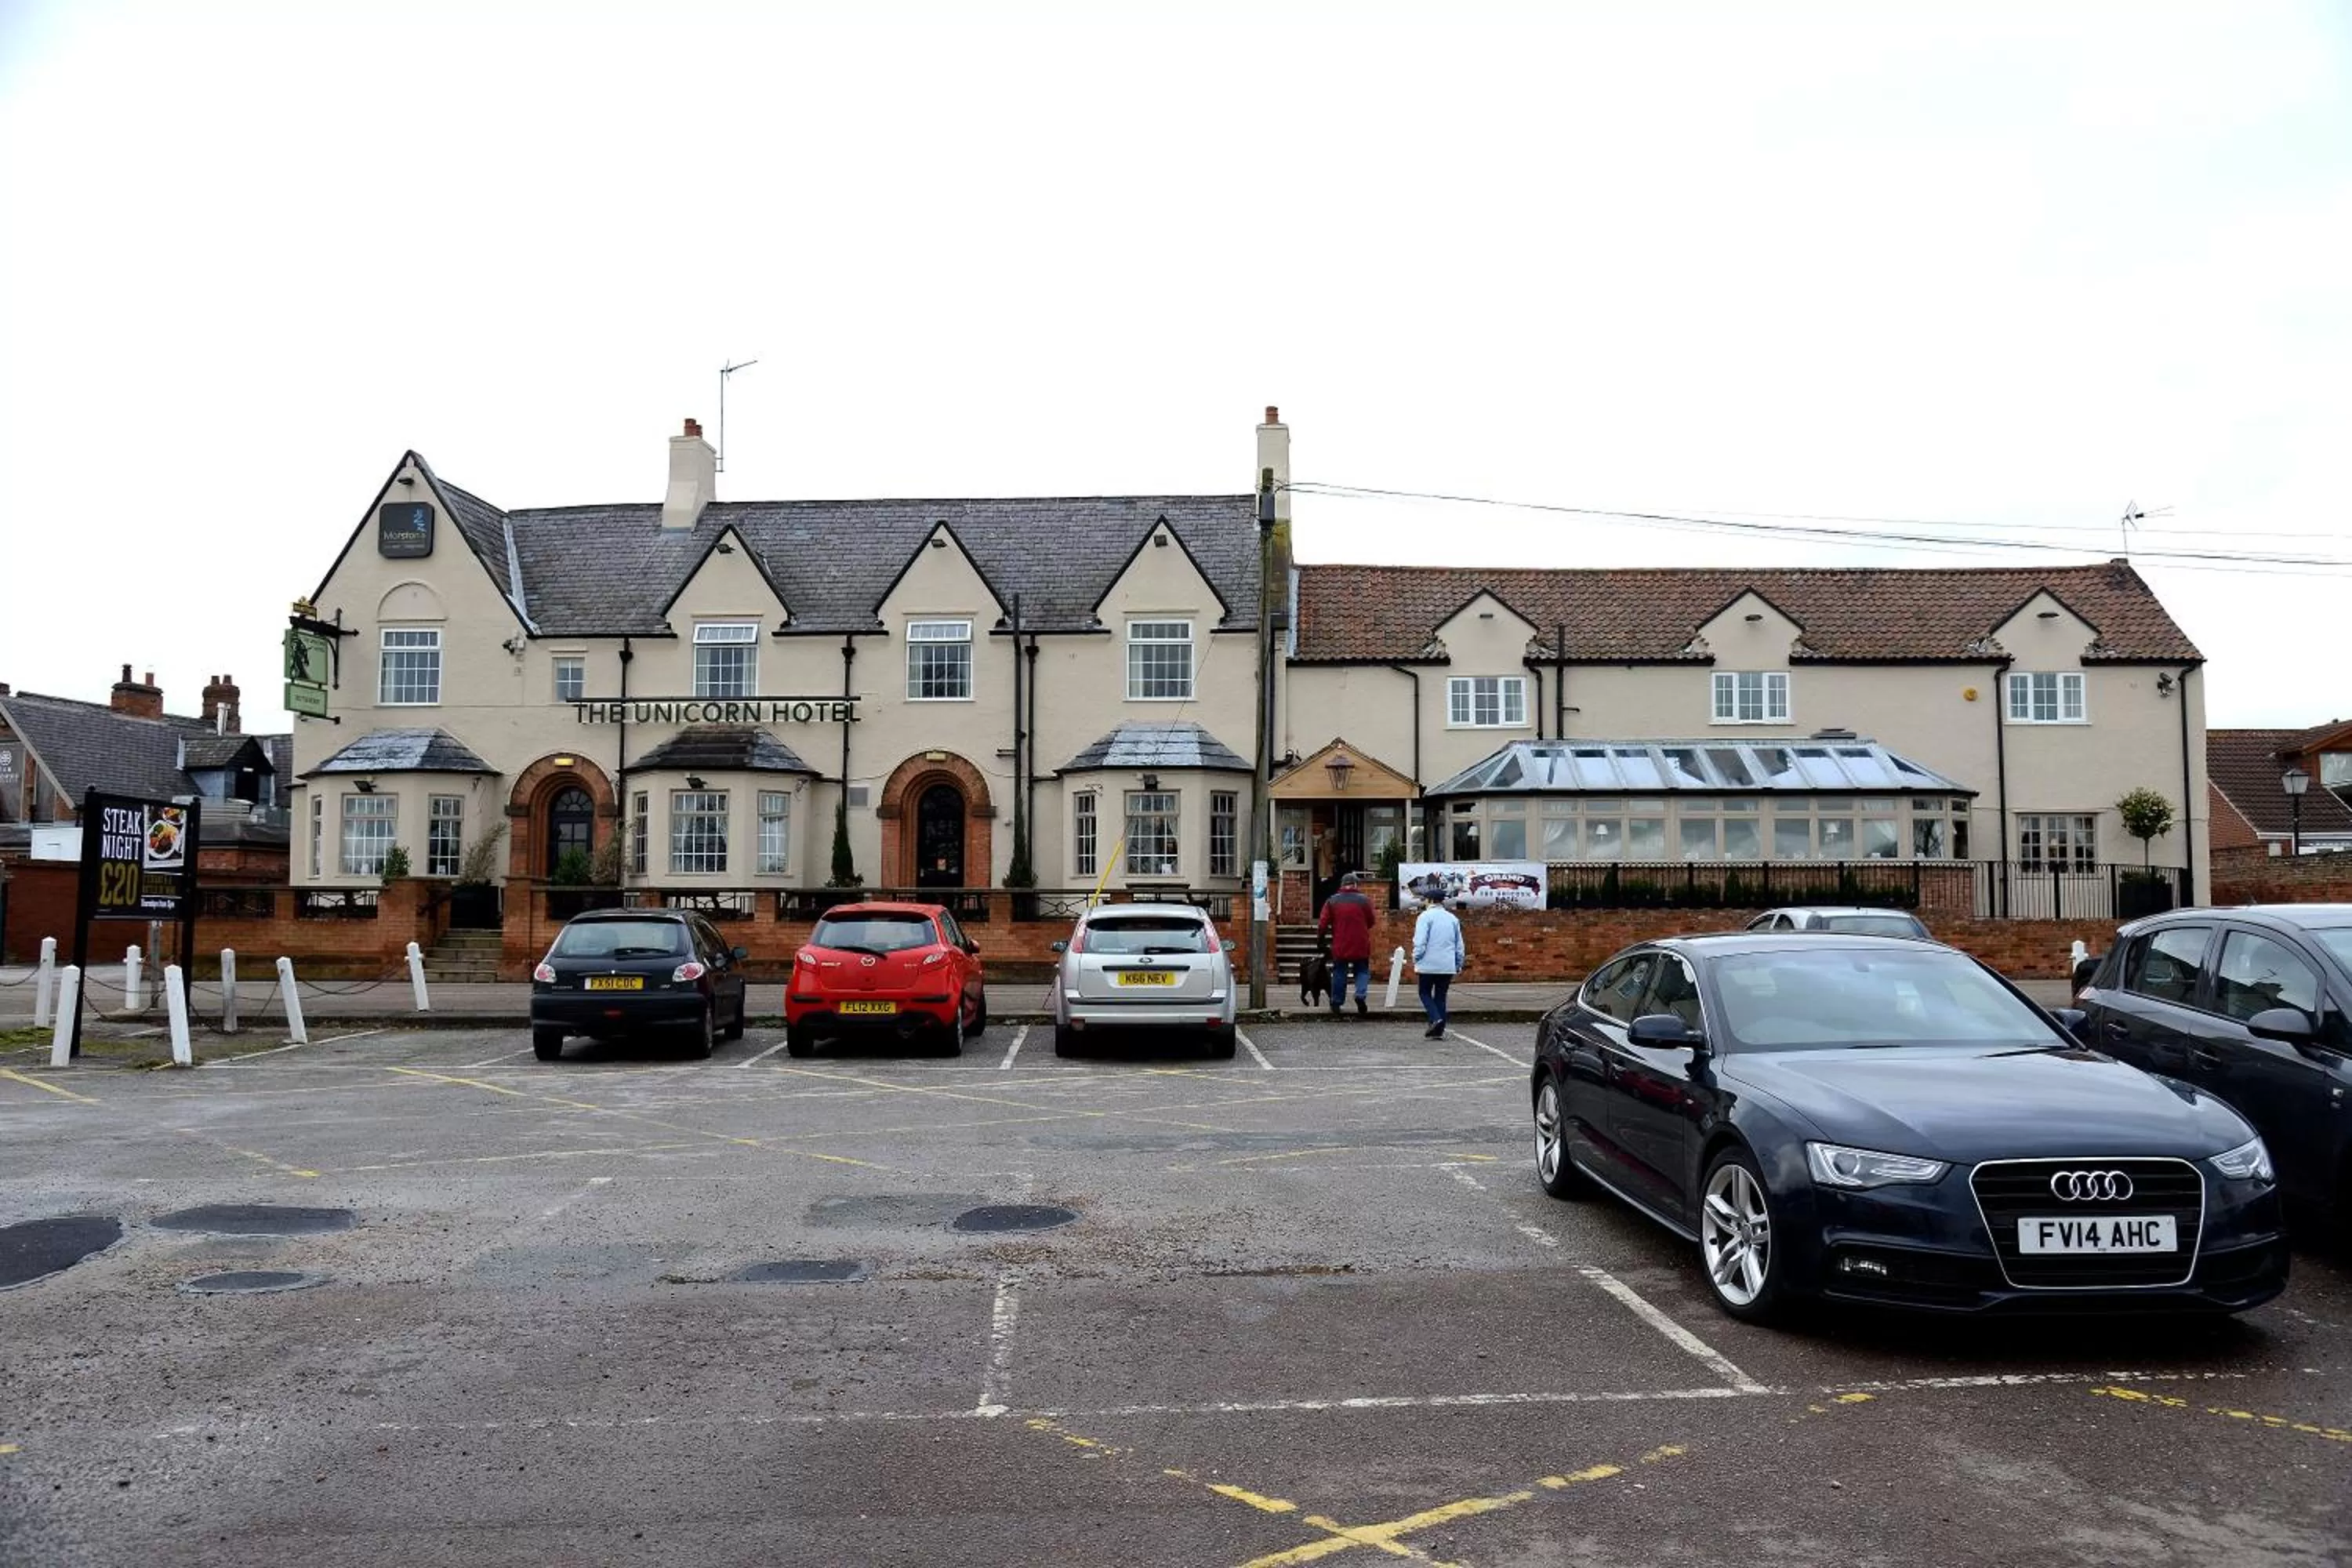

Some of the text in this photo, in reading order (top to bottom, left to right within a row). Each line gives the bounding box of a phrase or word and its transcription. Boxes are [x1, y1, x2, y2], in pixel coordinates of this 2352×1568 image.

[575, 702, 862, 723] THE UNICORN HOTEL
[103, 808, 142, 835] STEAK
[101, 833, 142, 860] NIGHT
[100, 862, 139, 906] £20
[2039, 1220, 2161, 1248] FV14 AHC
